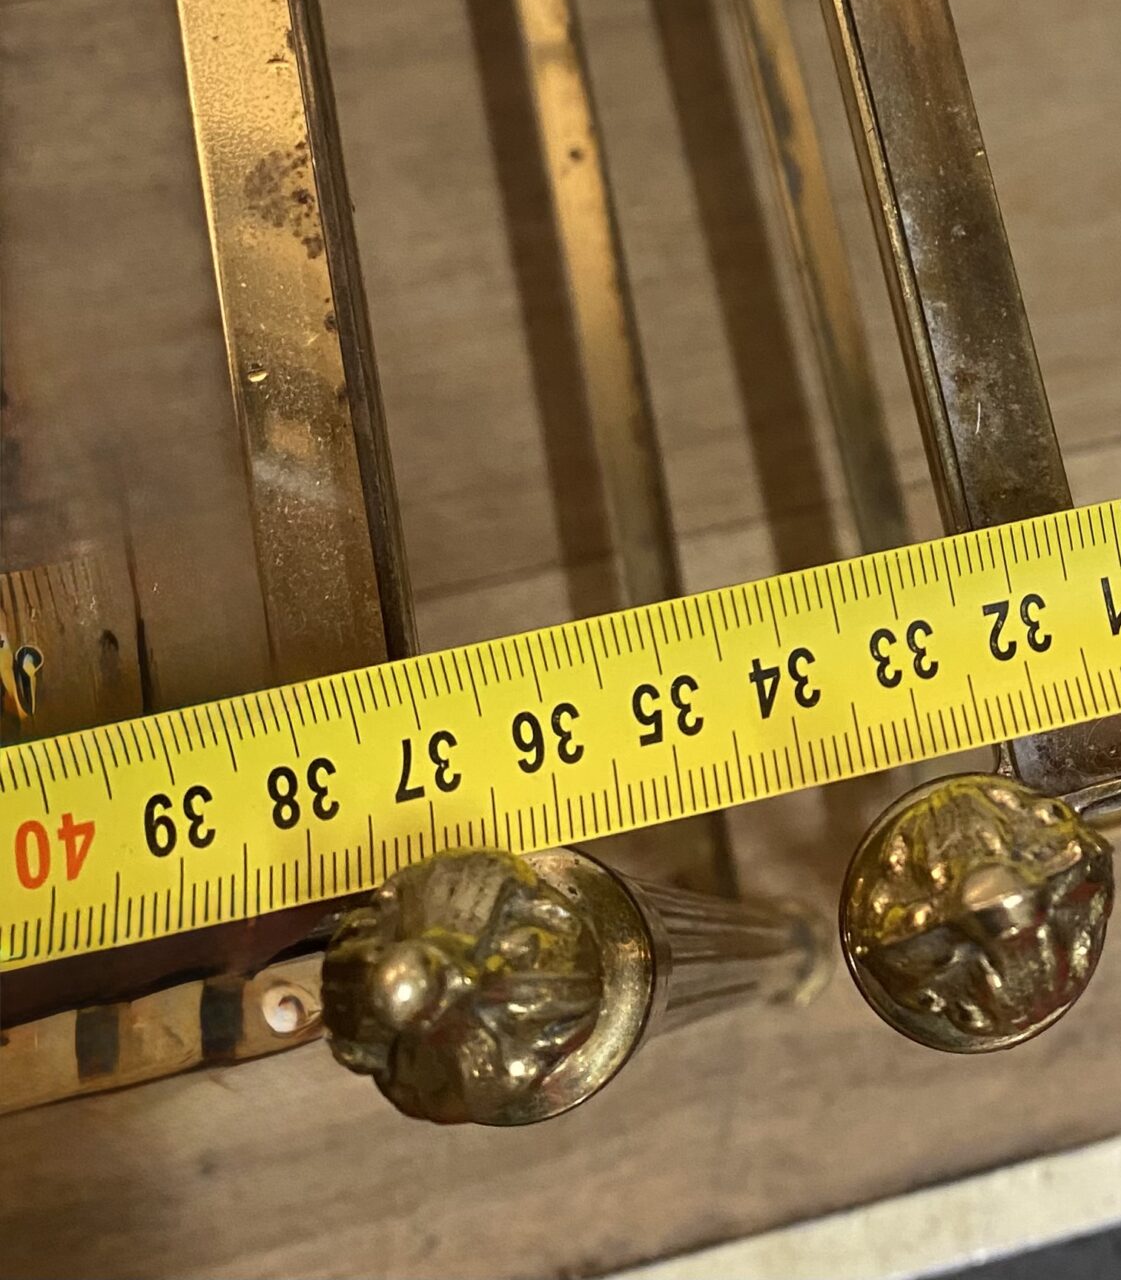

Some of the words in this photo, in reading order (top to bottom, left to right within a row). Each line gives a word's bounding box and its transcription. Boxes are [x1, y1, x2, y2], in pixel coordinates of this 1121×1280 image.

[869, 619, 940, 689] 33
[982, 592, 1053, 661] 32
[631, 674, 705, 747] 35
[749, 646, 821, 719] 34
[394, 730, 462, 804] 37
[511, 702, 586, 774] 36
[144, 785, 216, 857] 39
[266, 757, 341, 830] 38
[14, 813, 96, 890] 40
